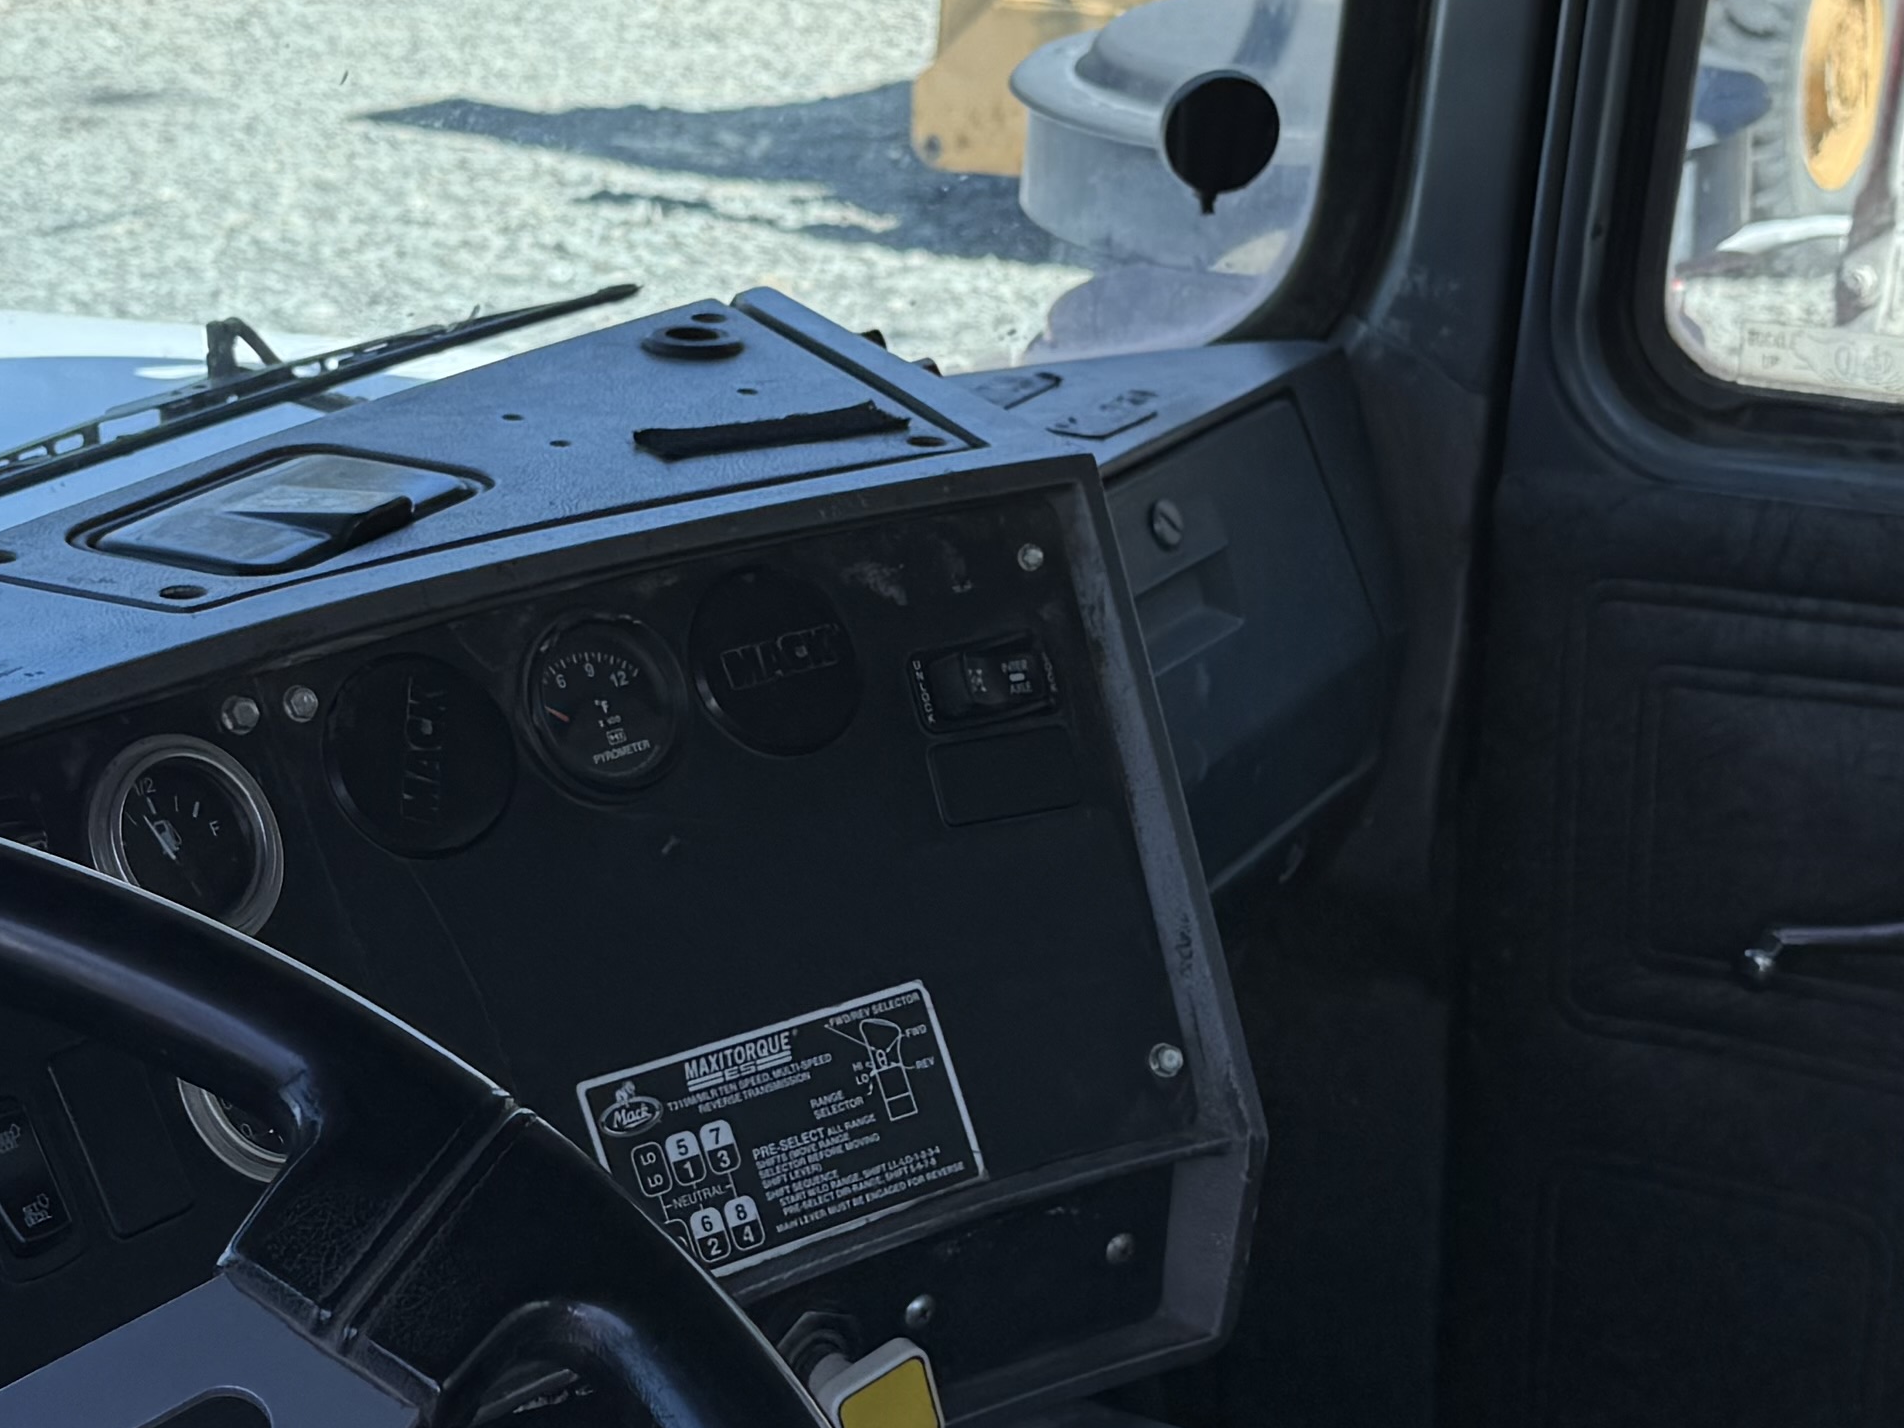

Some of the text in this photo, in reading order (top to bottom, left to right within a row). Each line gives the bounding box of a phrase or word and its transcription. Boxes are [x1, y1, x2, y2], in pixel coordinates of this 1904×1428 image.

[583, 662, 595, 678] 9
[609, 670, 629, 688] 12
[555, 673, 567, 689] 6
[911, 659, 936, 725] UNLOCK
[592, 738, 652, 764] PYROMETER
[209, 819, 221, 837] F
[871, 991, 920, 1015] SELECTOR
[905, 1024, 927, 1038] FWD
[684, 1031, 792, 1080] MAXITORQUE
[915, 1056, 935, 1070] REV
[855, 1073, 870, 1086] LO
[698, 1071, 811, 1114] REVERSE TRANSMISSION
[809, 1089, 845, 1109] RANGE
[612, 1103, 652, 1130] Mack
[813, 1096, 865, 1120] SELECTOR
[709, 1127, 721, 1145] 7
[752, 1113, 877, 1160] PRE-SELECT ALL RANGE
[818, 1132, 850, 1150] RANGE
[676, 1138, 688, 1156] 5
[639, 1151, 656, 1166] LO
[716, 1150, 730, 1168] 3
[758, 1133, 880, 1180] SELECTOR BEFORE MOVING
[683, 1161, 694, 1178] 1
[647, 1173, 663, 1188] LO
[761, 1172, 790, 1190] SHIFT
[765, 1169, 839, 1202] SHIFT SEQUENCE
[672, 1183, 726, 1209] NEUTRAL
[776, 1161, 965, 1233] MAIN LEVER MUST BE ENGAGED FOR REVERSE
[779, 1193, 805, 1208] START
[735, 1203, 747, 1221] 8
[701, 1215, 713, 1232] 6
[743, 1225, 755, 1243] 4
[706, 1237, 722, 1256] 2
